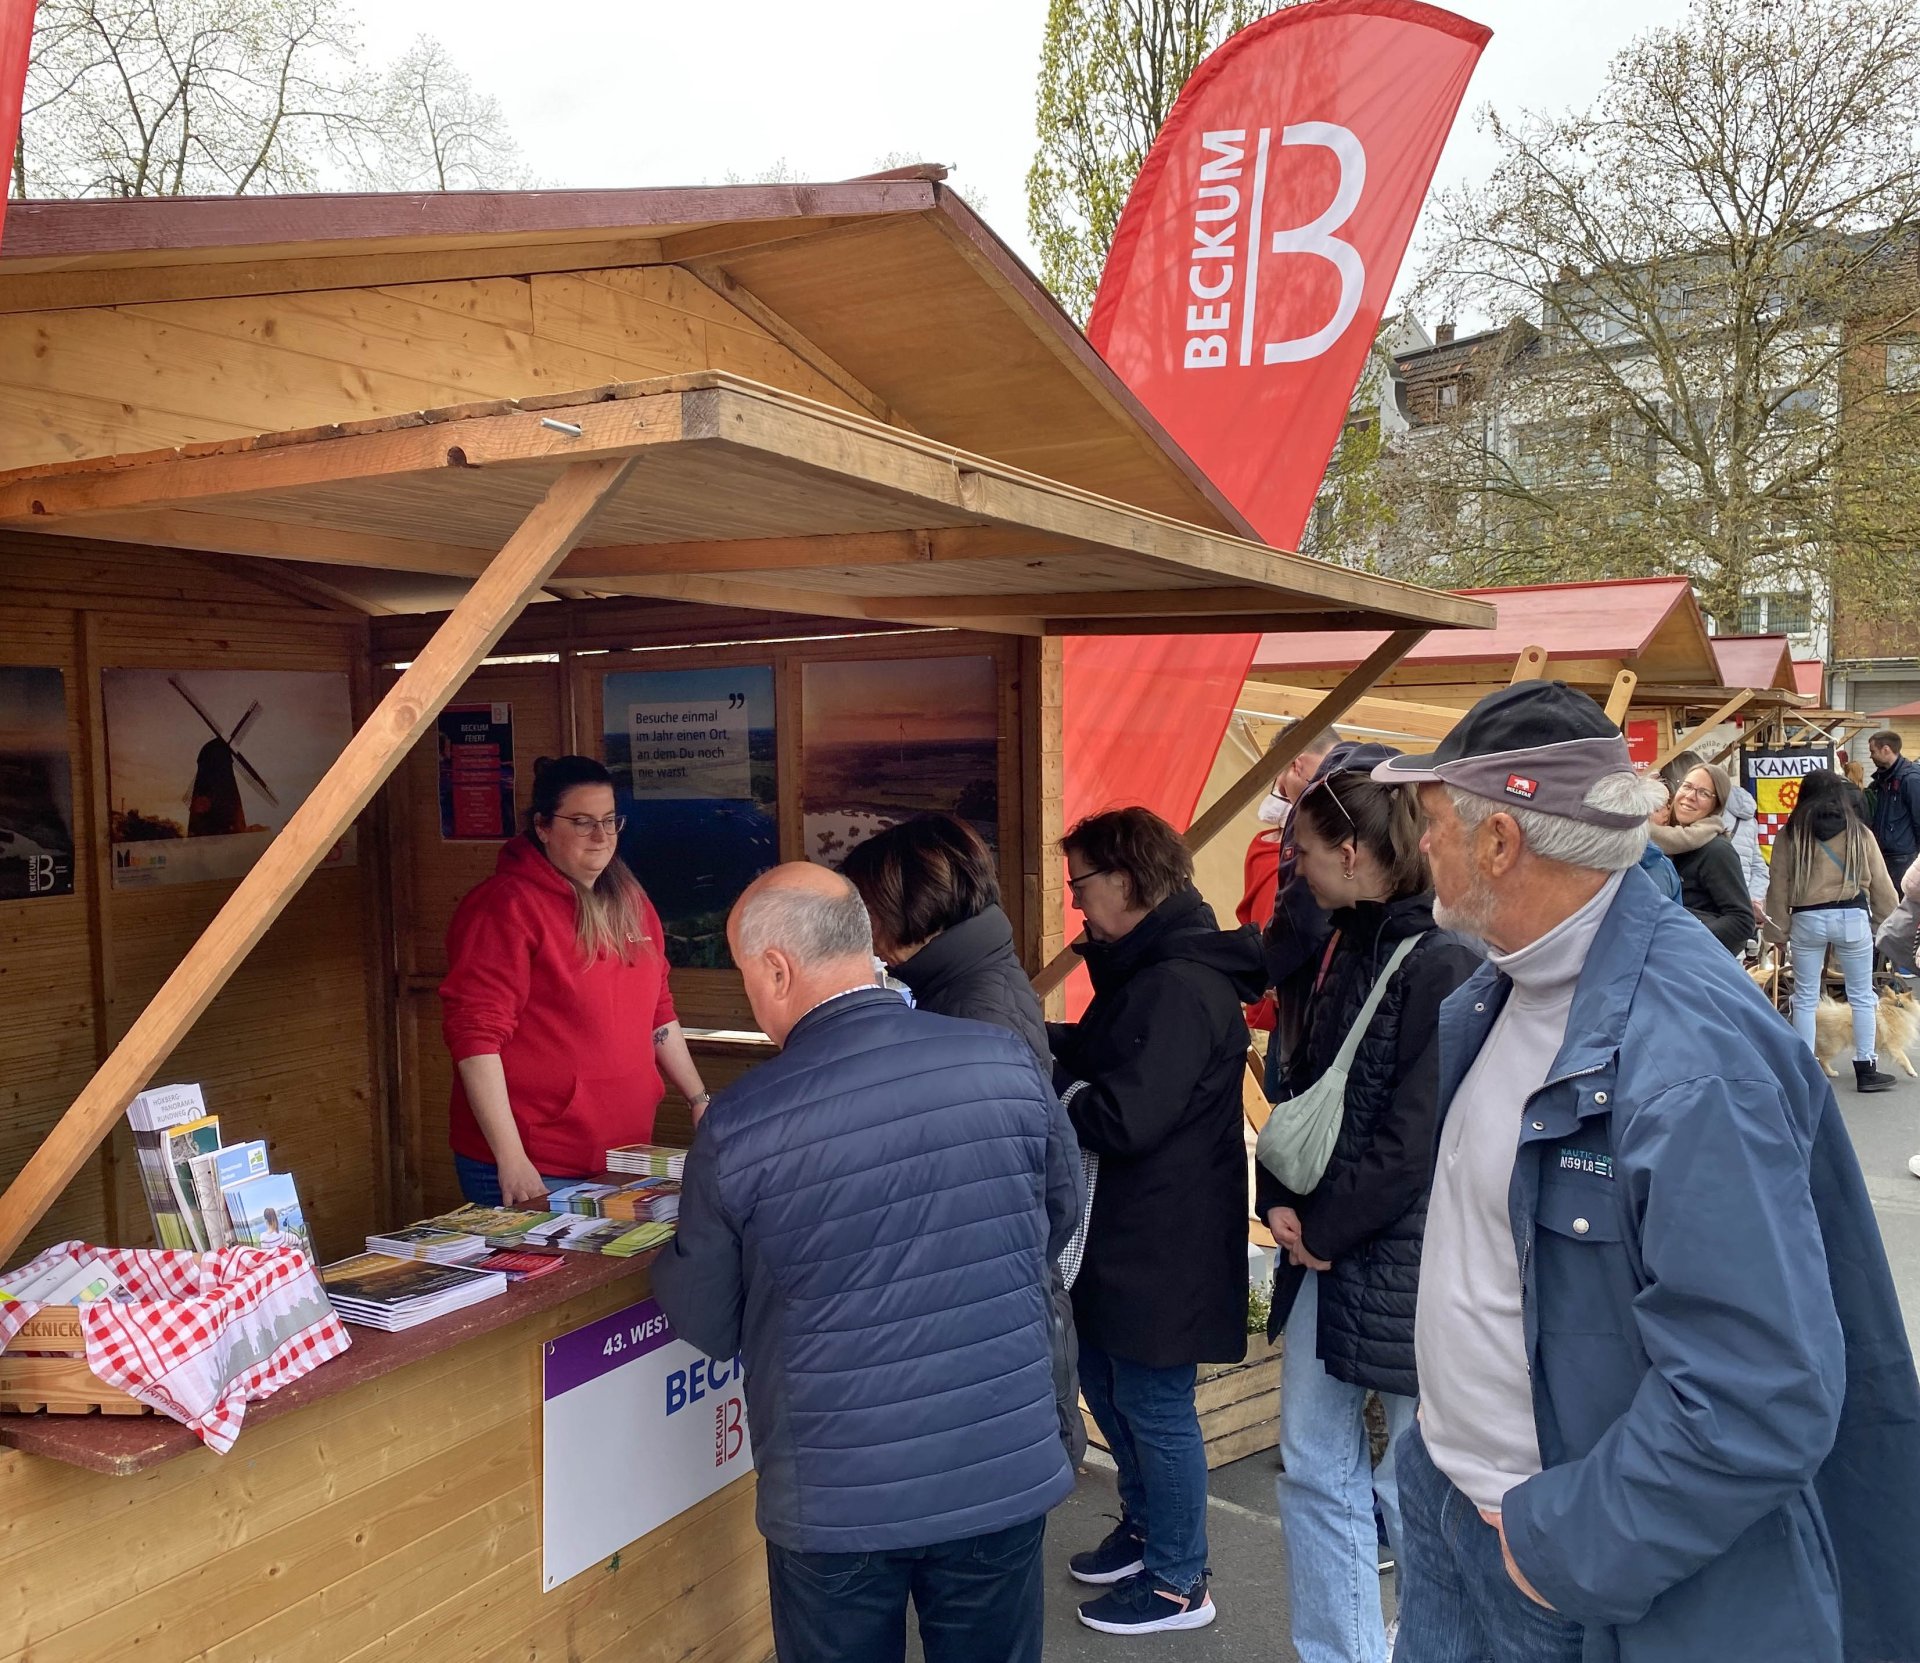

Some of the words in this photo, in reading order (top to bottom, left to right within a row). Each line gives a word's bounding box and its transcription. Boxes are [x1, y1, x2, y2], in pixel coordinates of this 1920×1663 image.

[1184, 129, 1246, 368] BECKUM
[635, 711, 679, 724] Besuche
[681, 709, 718, 722] einmal
[636, 731, 649, 742] im
[651, 730, 674, 743] Jahr
[676, 728, 706, 740] einen
[709, 728, 731, 741] Ort,
[636, 750, 650, 760] an
[653, 748, 676, 760] dem
[680, 747, 694, 759] Du
[697, 745, 725, 759] noch
[638, 767, 654, 778] nie
[656, 765, 689, 779] warst.
[1754, 758, 1823, 777] KAMEN
[29, 855, 37, 892] BECKUM
[1561, 1148, 1593, 1159] NAUTIC
[603, 1332, 627, 1356] 43.
[715, 1403, 724, 1468] BECKUM
